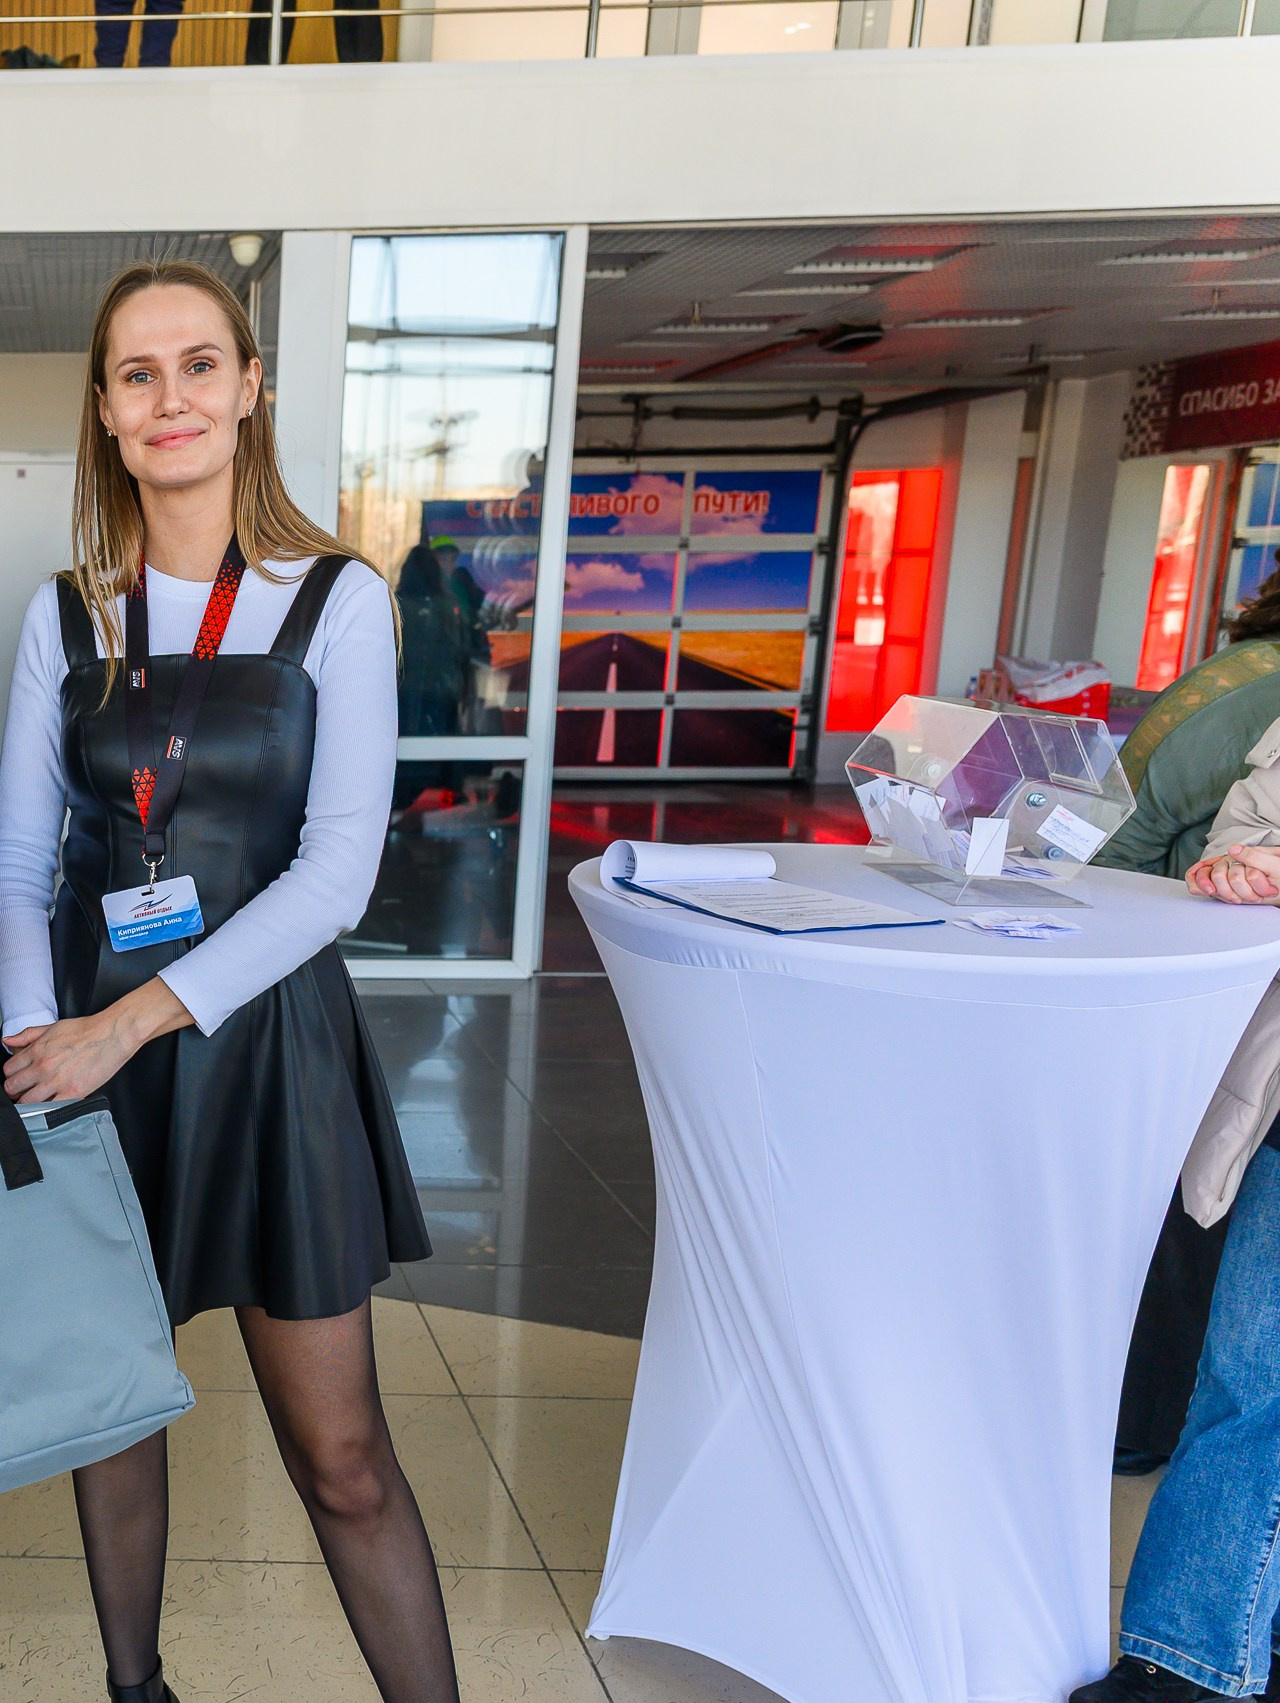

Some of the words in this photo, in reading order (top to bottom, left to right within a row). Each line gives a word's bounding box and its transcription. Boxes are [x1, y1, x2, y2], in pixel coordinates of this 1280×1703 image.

[1179, 381, 1259, 416] СПАСИБО
[694, 491, 769, 514] ПУТИ!
[132, 671, 140, 687] AVS
[172, 738, 183, 758] AVS
[133, 909, 157, 919] АКТИВНЫЙ
[117, 921, 162, 936] Киприянова
[163, 917, 183, 926] Анна
